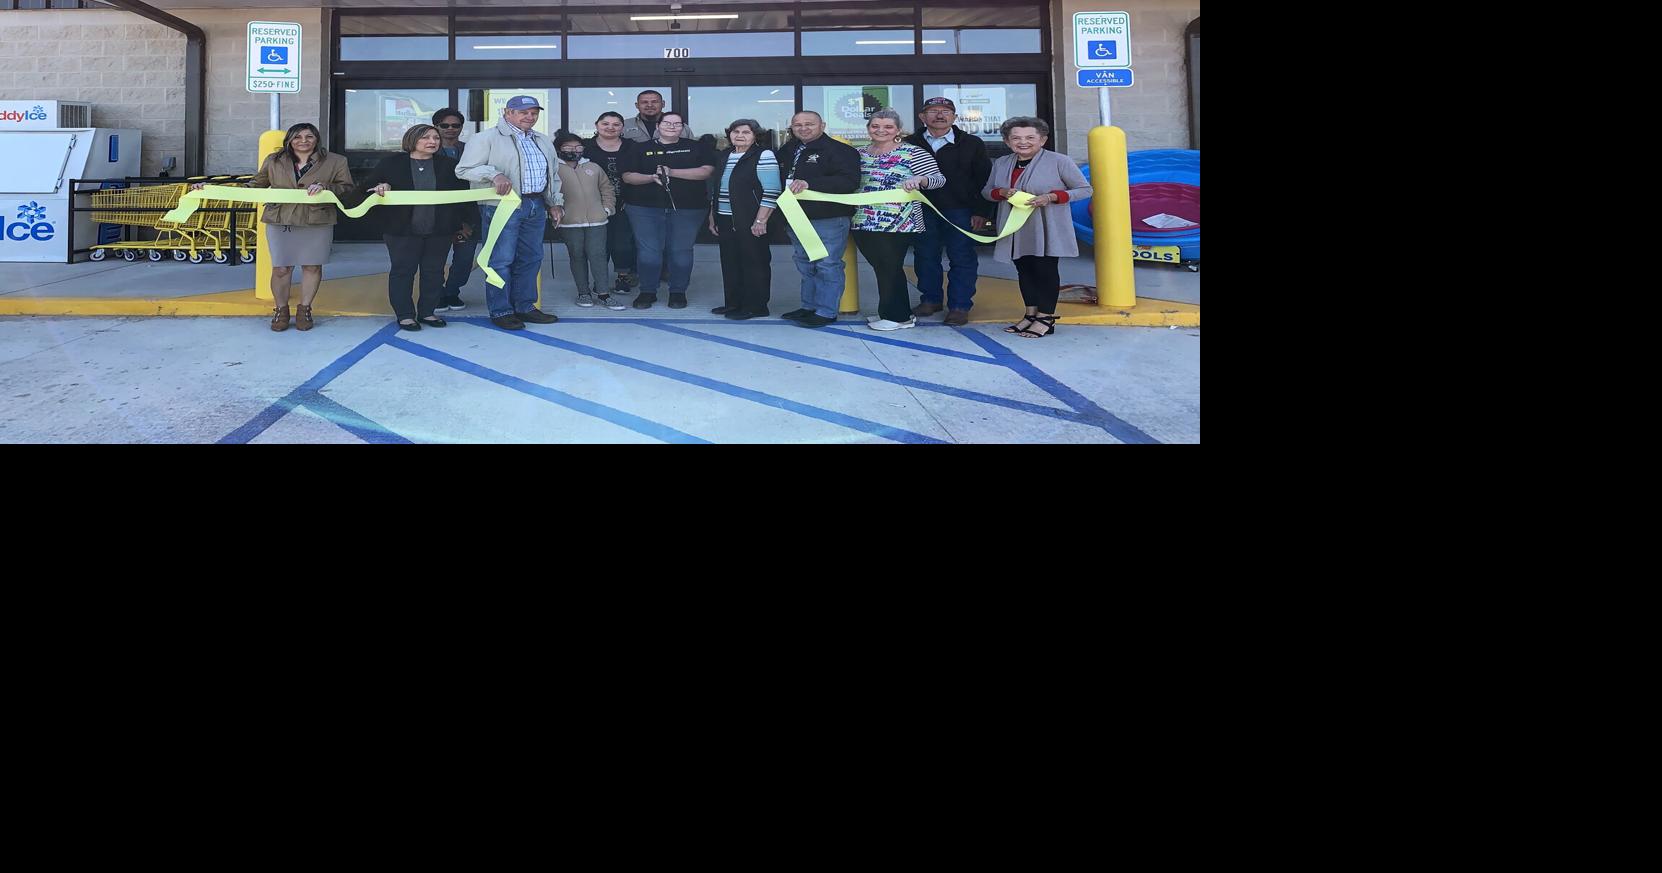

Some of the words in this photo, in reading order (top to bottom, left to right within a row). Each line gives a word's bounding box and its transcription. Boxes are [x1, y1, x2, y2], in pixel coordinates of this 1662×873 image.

[1078, 17, 1125, 25] RESERVED
[252, 28, 298, 36] RESERVED
[665, 48, 689, 58] 700
[253, 80, 273, 88] $250
[847, 97, 864, 112] $1
[983, 122, 1001, 134] UP
[0, 215, 55, 241] Ice
